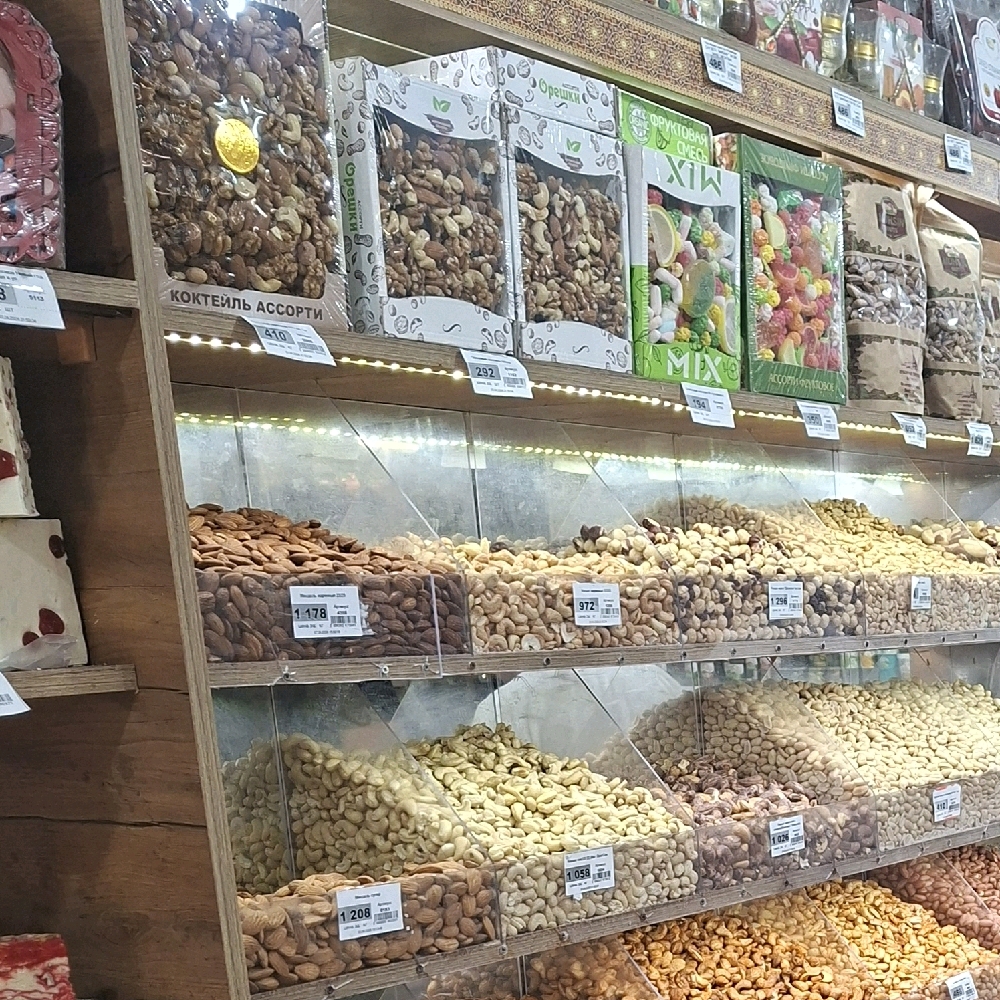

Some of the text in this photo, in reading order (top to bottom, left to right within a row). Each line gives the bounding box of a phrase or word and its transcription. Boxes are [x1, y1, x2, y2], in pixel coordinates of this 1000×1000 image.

[650, 113, 708, 147] ФРУКТОВАЯ
[677, 141, 708, 163] СМЕСЬ
[344, 161, 358, 232] Орешки
[170, 289, 323, 321] КОКТЕЙЛЬ АССОРТИ
[265, 326, 286, 343] 410
[475, 366, 495, 378] 292
[667, 349, 723, 383] MIX
[305, 608, 327, 619] 178
[578, 601, 595, 611] 972
[350, 907, 371, 920] 208
